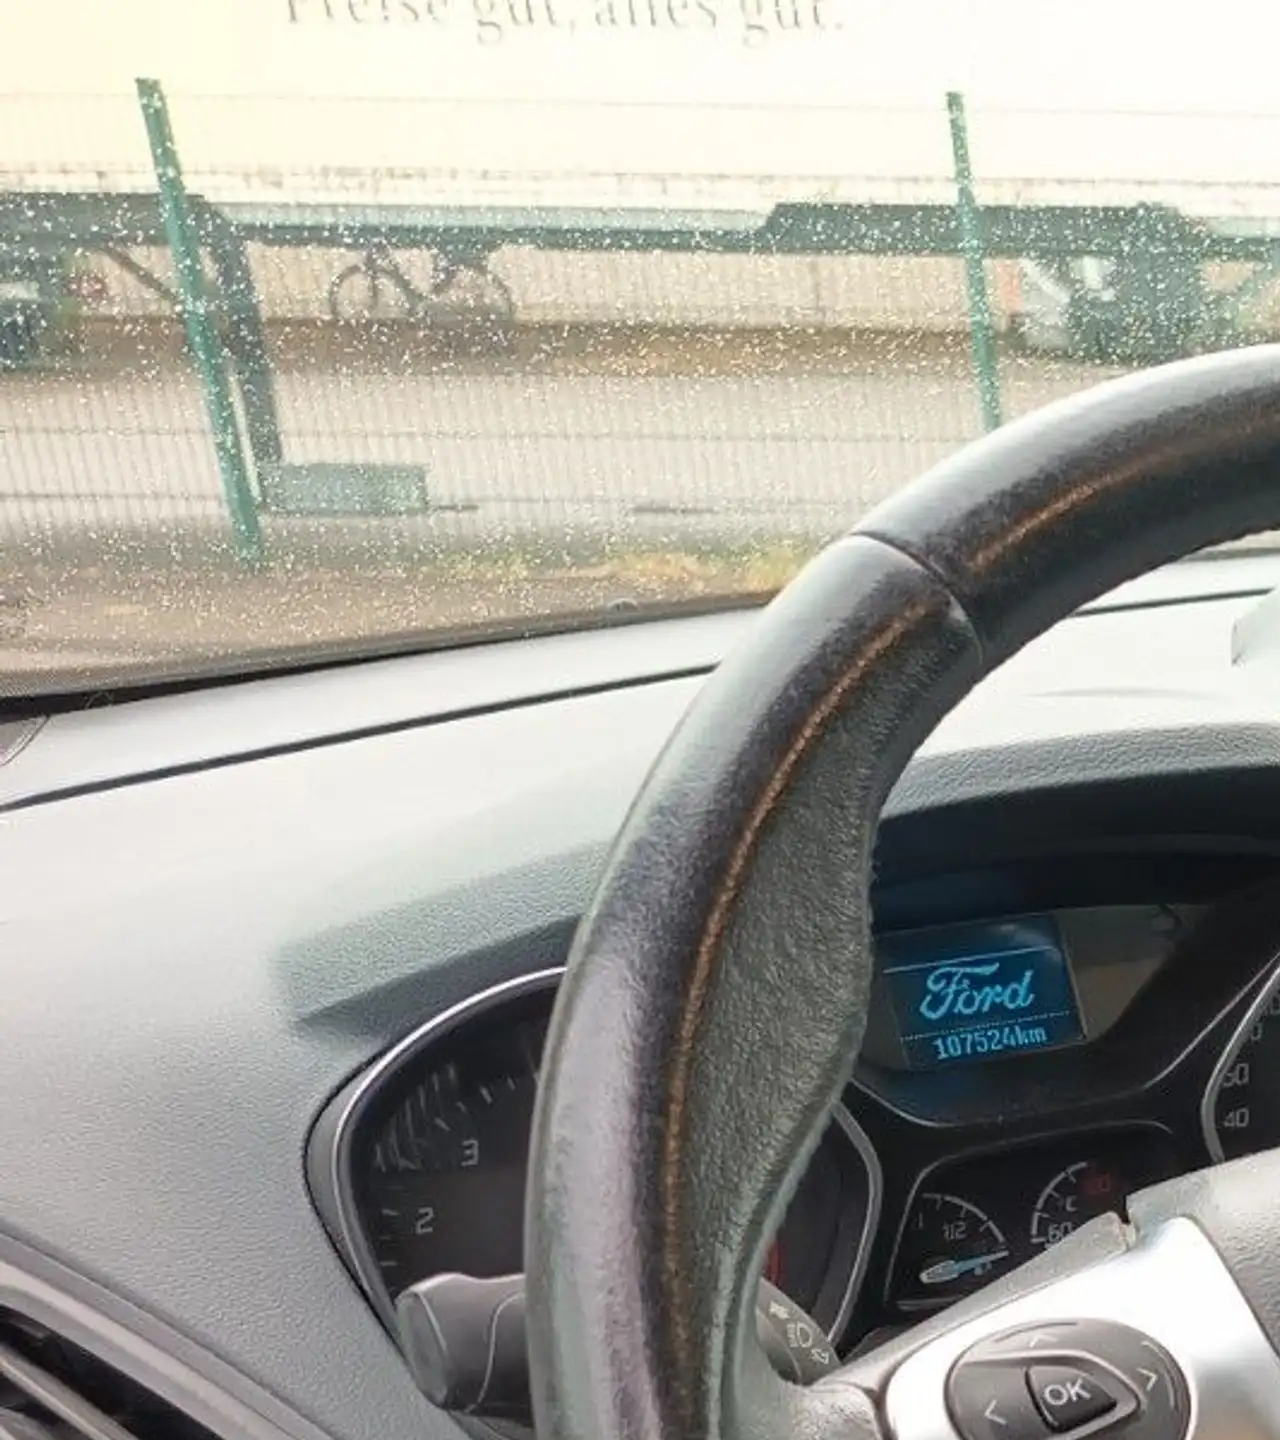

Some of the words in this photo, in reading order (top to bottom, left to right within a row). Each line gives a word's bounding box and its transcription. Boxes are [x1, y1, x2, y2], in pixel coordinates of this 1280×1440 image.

[919, 962, 1036, 1020] Ford
[932, 1025, 1048, 1060] 107524km
[1223, 1107, 1250, 1129] 40
[461, 1140, 480, 1167] 3
[415, 1207, 434, 1235] 2
[1043, 1377, 1092, 1406] OK
